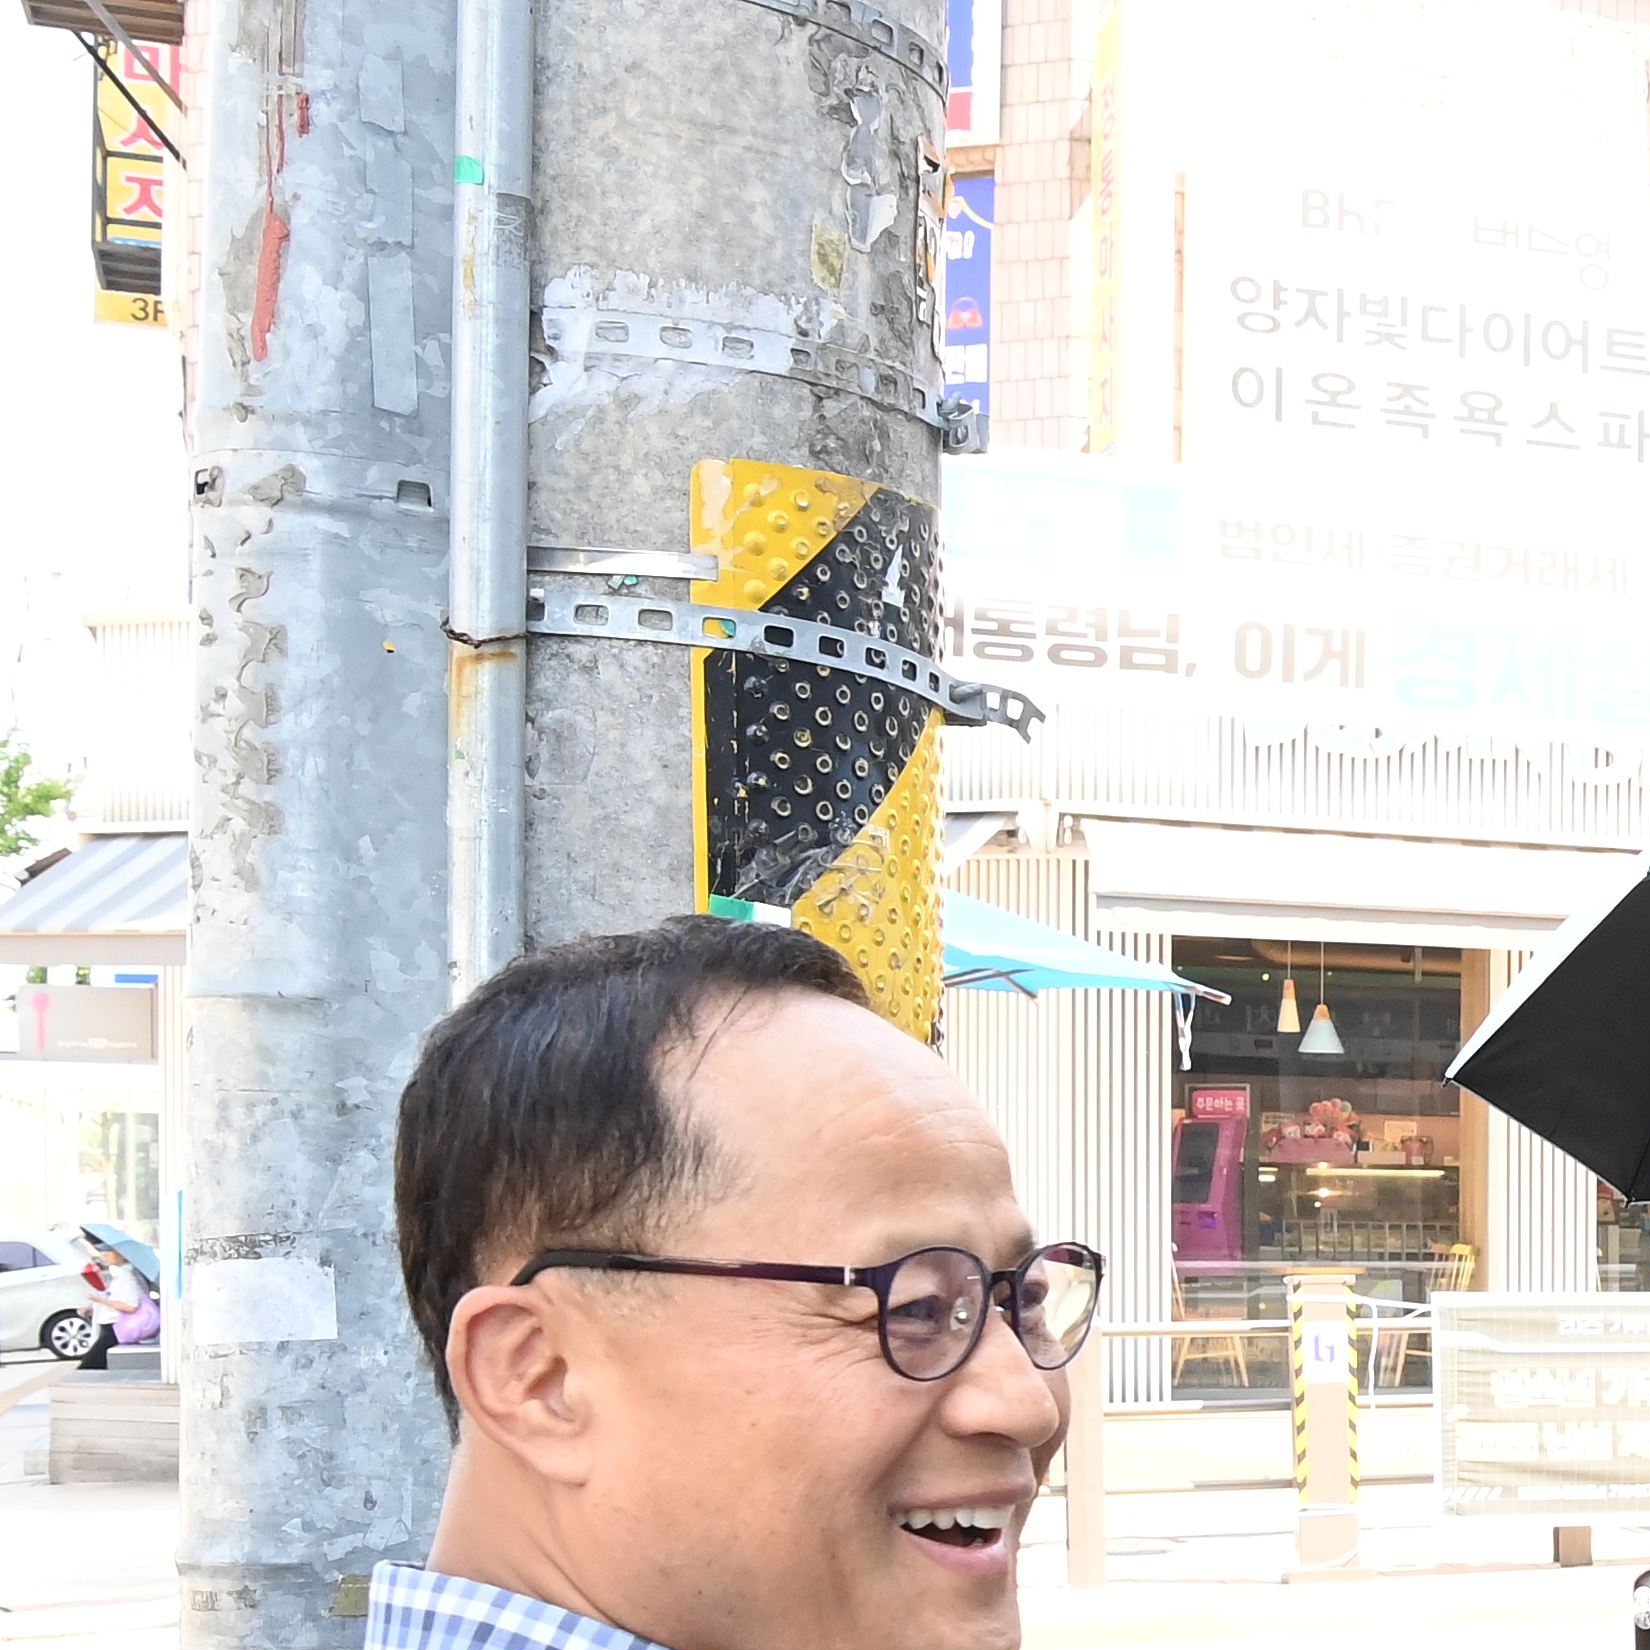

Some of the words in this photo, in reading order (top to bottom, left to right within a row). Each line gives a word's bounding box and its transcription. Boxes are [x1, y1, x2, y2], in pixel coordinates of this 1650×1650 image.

[1219, 518, 1364, 569] 법인세
[1390, 534, 1629, 596] 증권거래세
[1233, 620, 1366, 689] 이게
[1197, 1097, 1233, 1110] 주문하는
